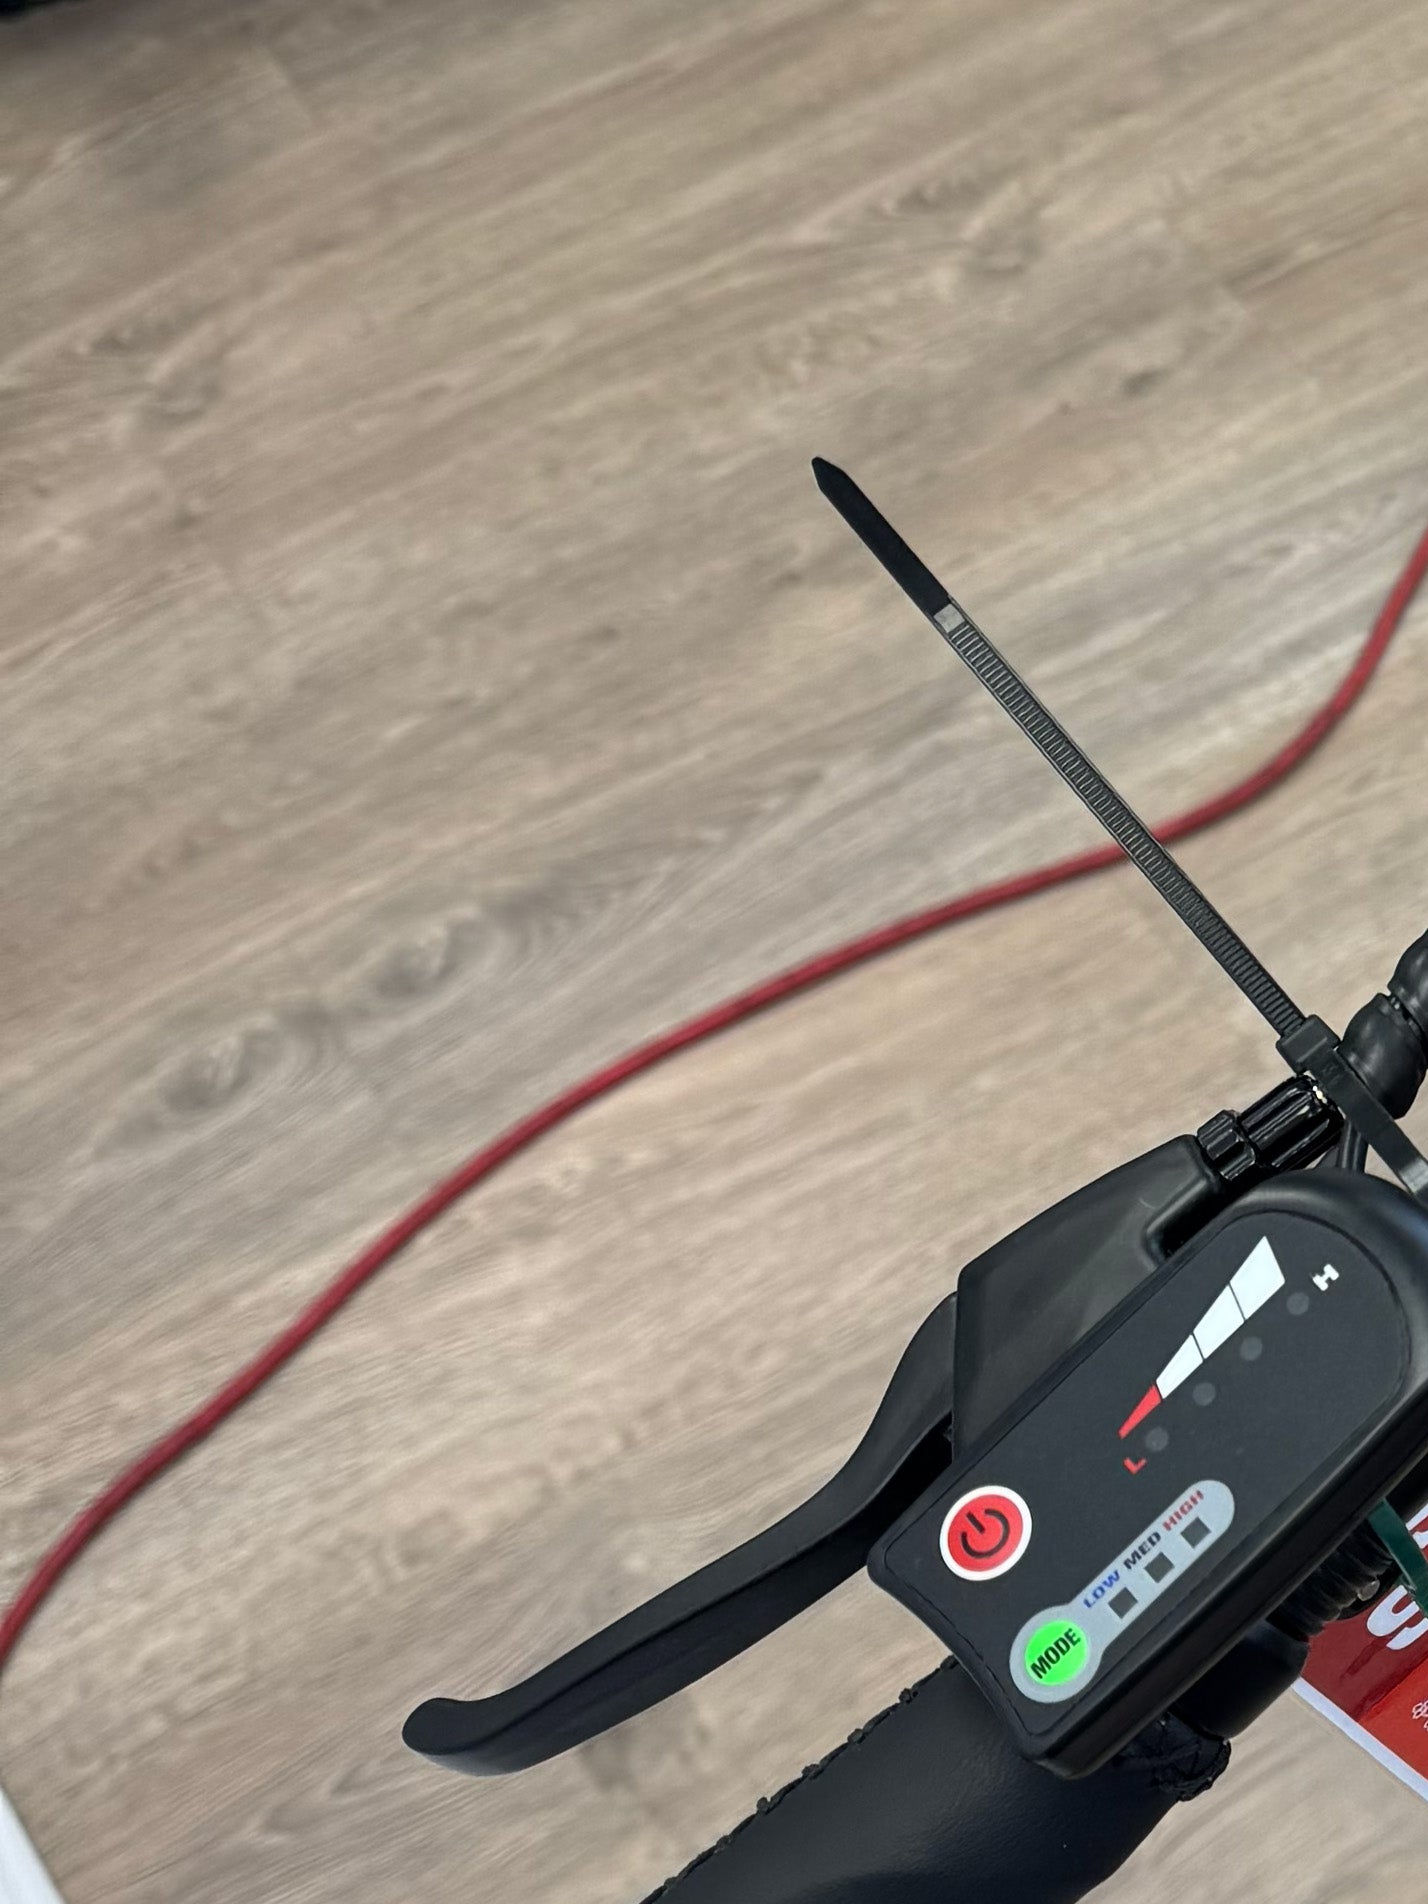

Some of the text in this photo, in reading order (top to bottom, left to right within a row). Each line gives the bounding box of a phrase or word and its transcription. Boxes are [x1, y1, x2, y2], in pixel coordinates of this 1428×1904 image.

[1312, 1263, 1340, 1292] H
[1122, 1456, 1148, 1475] L
[1083, 1489, 1204, 1609] LOW MED HIGH
[1029, 1627, 1081, 1680] MODE
